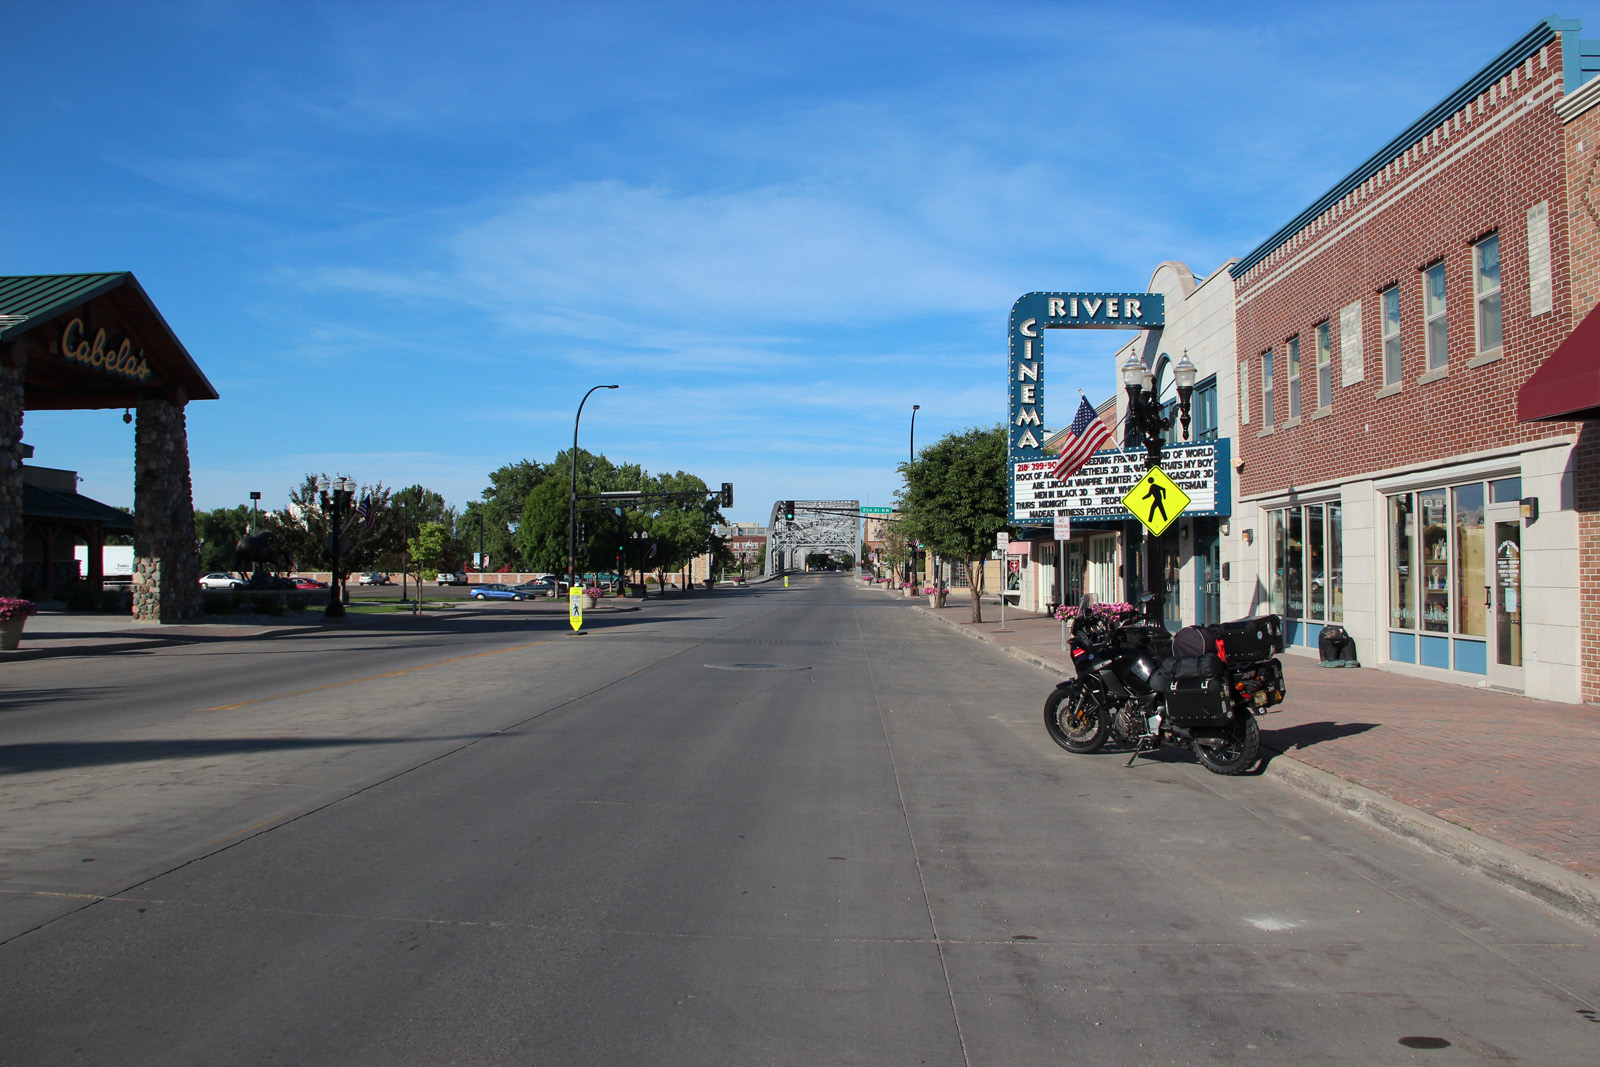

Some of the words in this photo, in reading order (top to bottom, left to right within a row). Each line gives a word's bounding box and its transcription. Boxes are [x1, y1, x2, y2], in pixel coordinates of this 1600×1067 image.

[1048, 297, 1142, 319] RIVER
[62, 318, 150, 379] Cabela's
[1015, 317, 1041, 449] CINEMA
[1139, 453, 1149, 461] FO
[1172, 450, 1184, 459] OF
[1185, 447, 1213, 458] WORLD
[1110, 466, 1119, 474] 3D
[1184, 460, 1196, 469] MY
[1197, 458, 1213, 468] BOY
[1016, 473, 1033, 481] ROCK
[1034, 472, 1042, 480] OF
[1032, 481, 1045, 490] ABE
[1075, 477, 1103, 487] VAMPIRE
[1105, 474, 1132, 485] HUNTER
[1203, 469, 1214, 478] 3D
[1034, 491, 1047, 499] MEN
[1048, 490, 1055, 498] IN
[1056, 488, 1078, 498] BLACK
[1079, 488, 1088, 496] 3D
[1094, 486, 1115, 496] SNOW
[1016, 501, 1036, 510] THURS
[1038, 499, 1068, 508] MIDNIGHT
[1079, 498, 1093, 506] TED
[1101, 496, 1124, 505] PEOPL
[1029, 510, 1055, 518] MADEAS
[1057, 508, 1085, 517] WITNESS
[1086, 506, 1129, 516] PROTECTION
